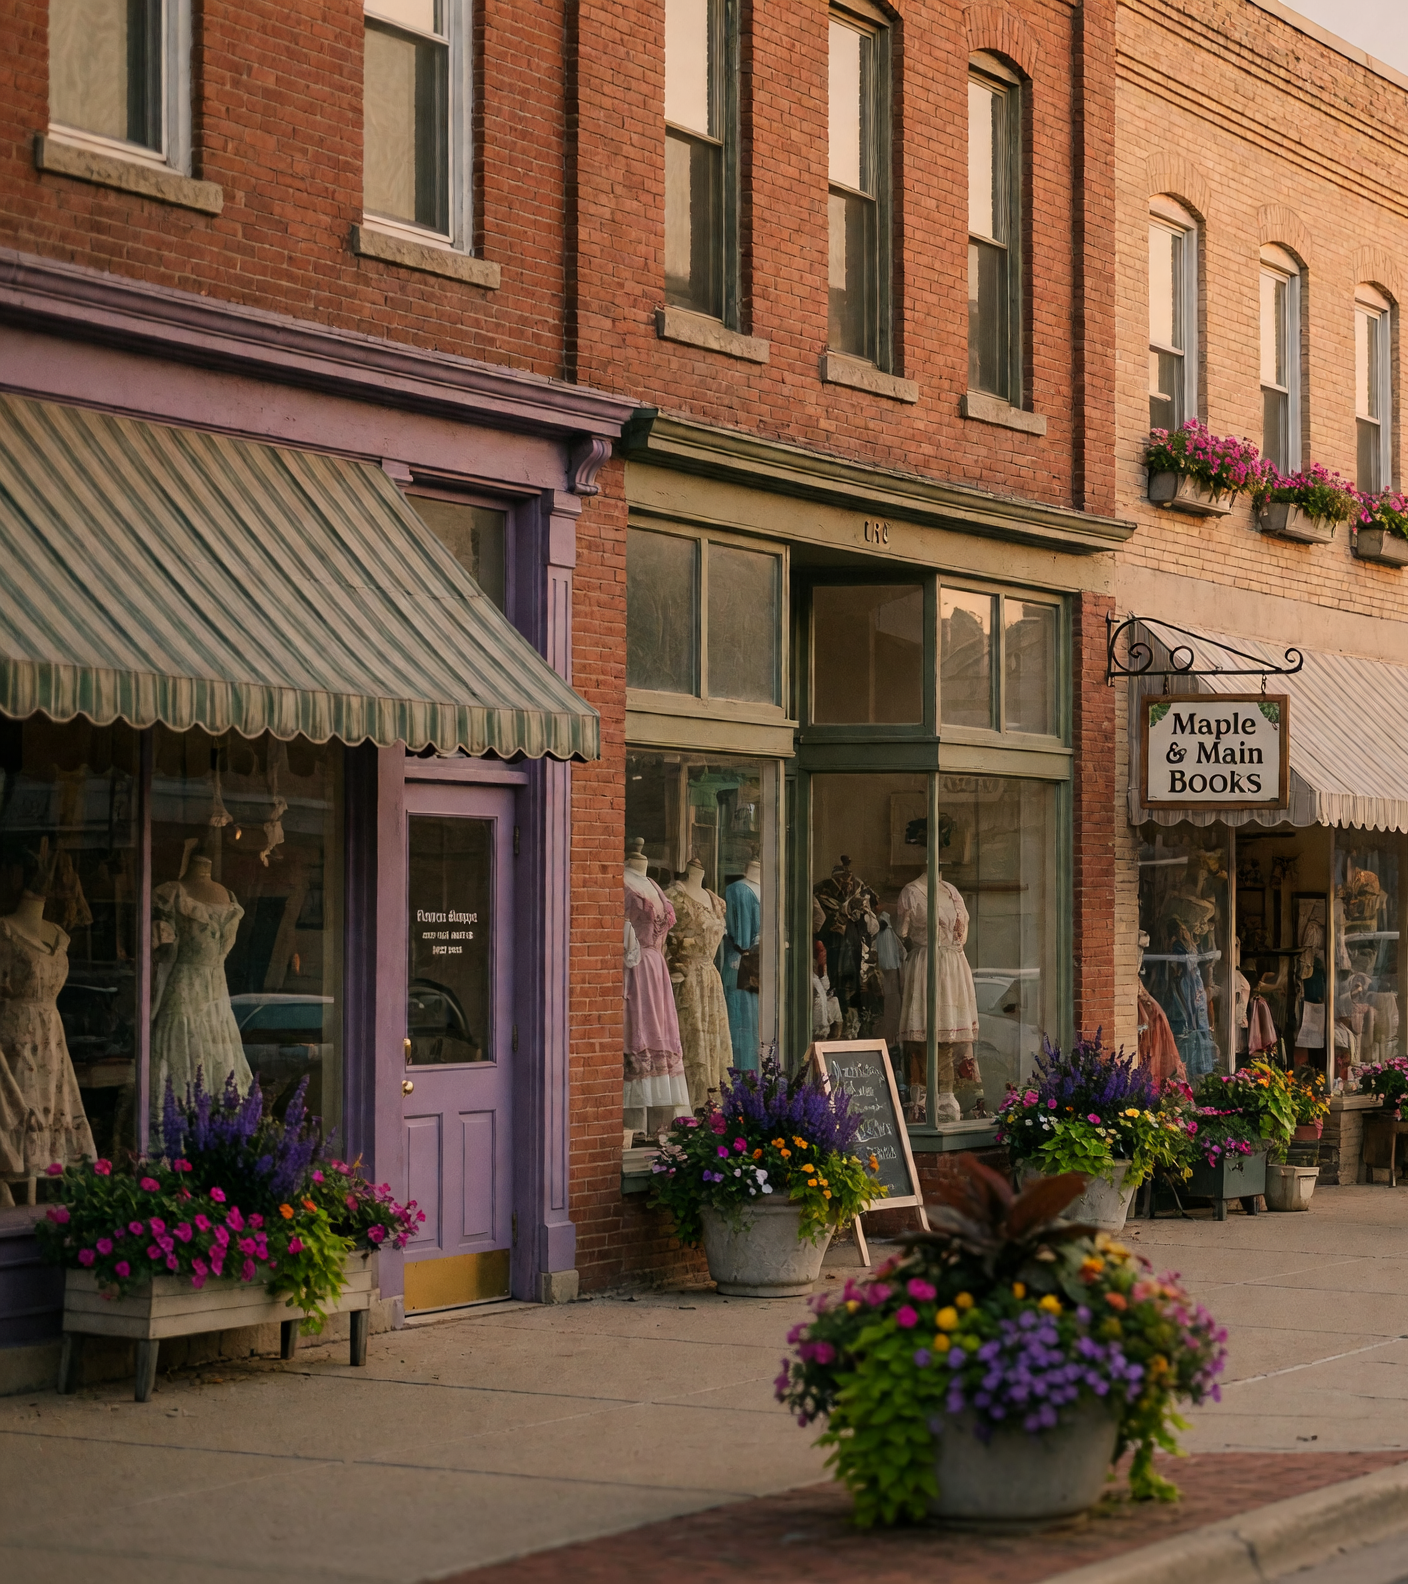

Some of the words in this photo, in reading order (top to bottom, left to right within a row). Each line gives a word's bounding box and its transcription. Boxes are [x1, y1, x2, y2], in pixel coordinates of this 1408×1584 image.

[1171, 712, 1256, 740] Maple
[1166, 741, 1187, 764] &
[1196, 741, 1263, 764] Main
[1168, 769, 1262, 793] Books
